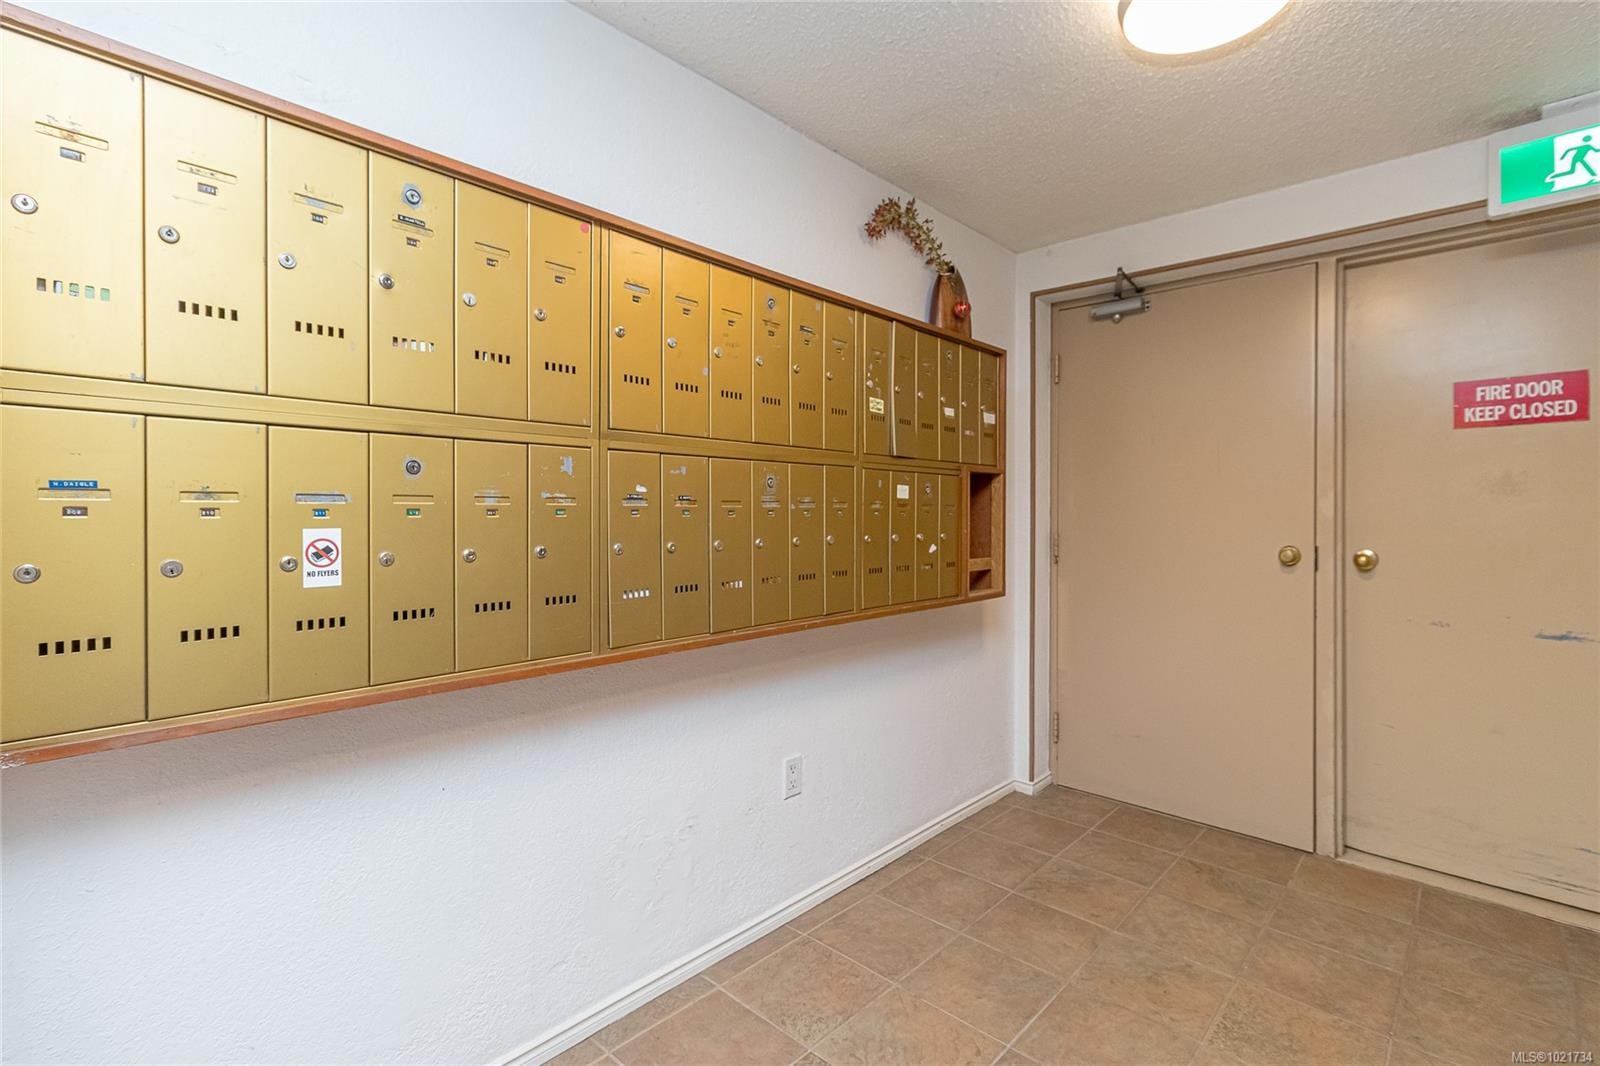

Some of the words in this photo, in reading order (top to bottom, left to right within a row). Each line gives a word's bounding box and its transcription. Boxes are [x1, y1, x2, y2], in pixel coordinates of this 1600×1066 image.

[1475, 384, 1512, 401] FIRE
[1515, 379, 1564, 398] DOOR
[1463, 405, 1506, 422] KEEP
[1509, 399, 1578, 419] CLOSED
[306, 570, 316, 578] NO
[317, 569, 339, 577] FLYERS
